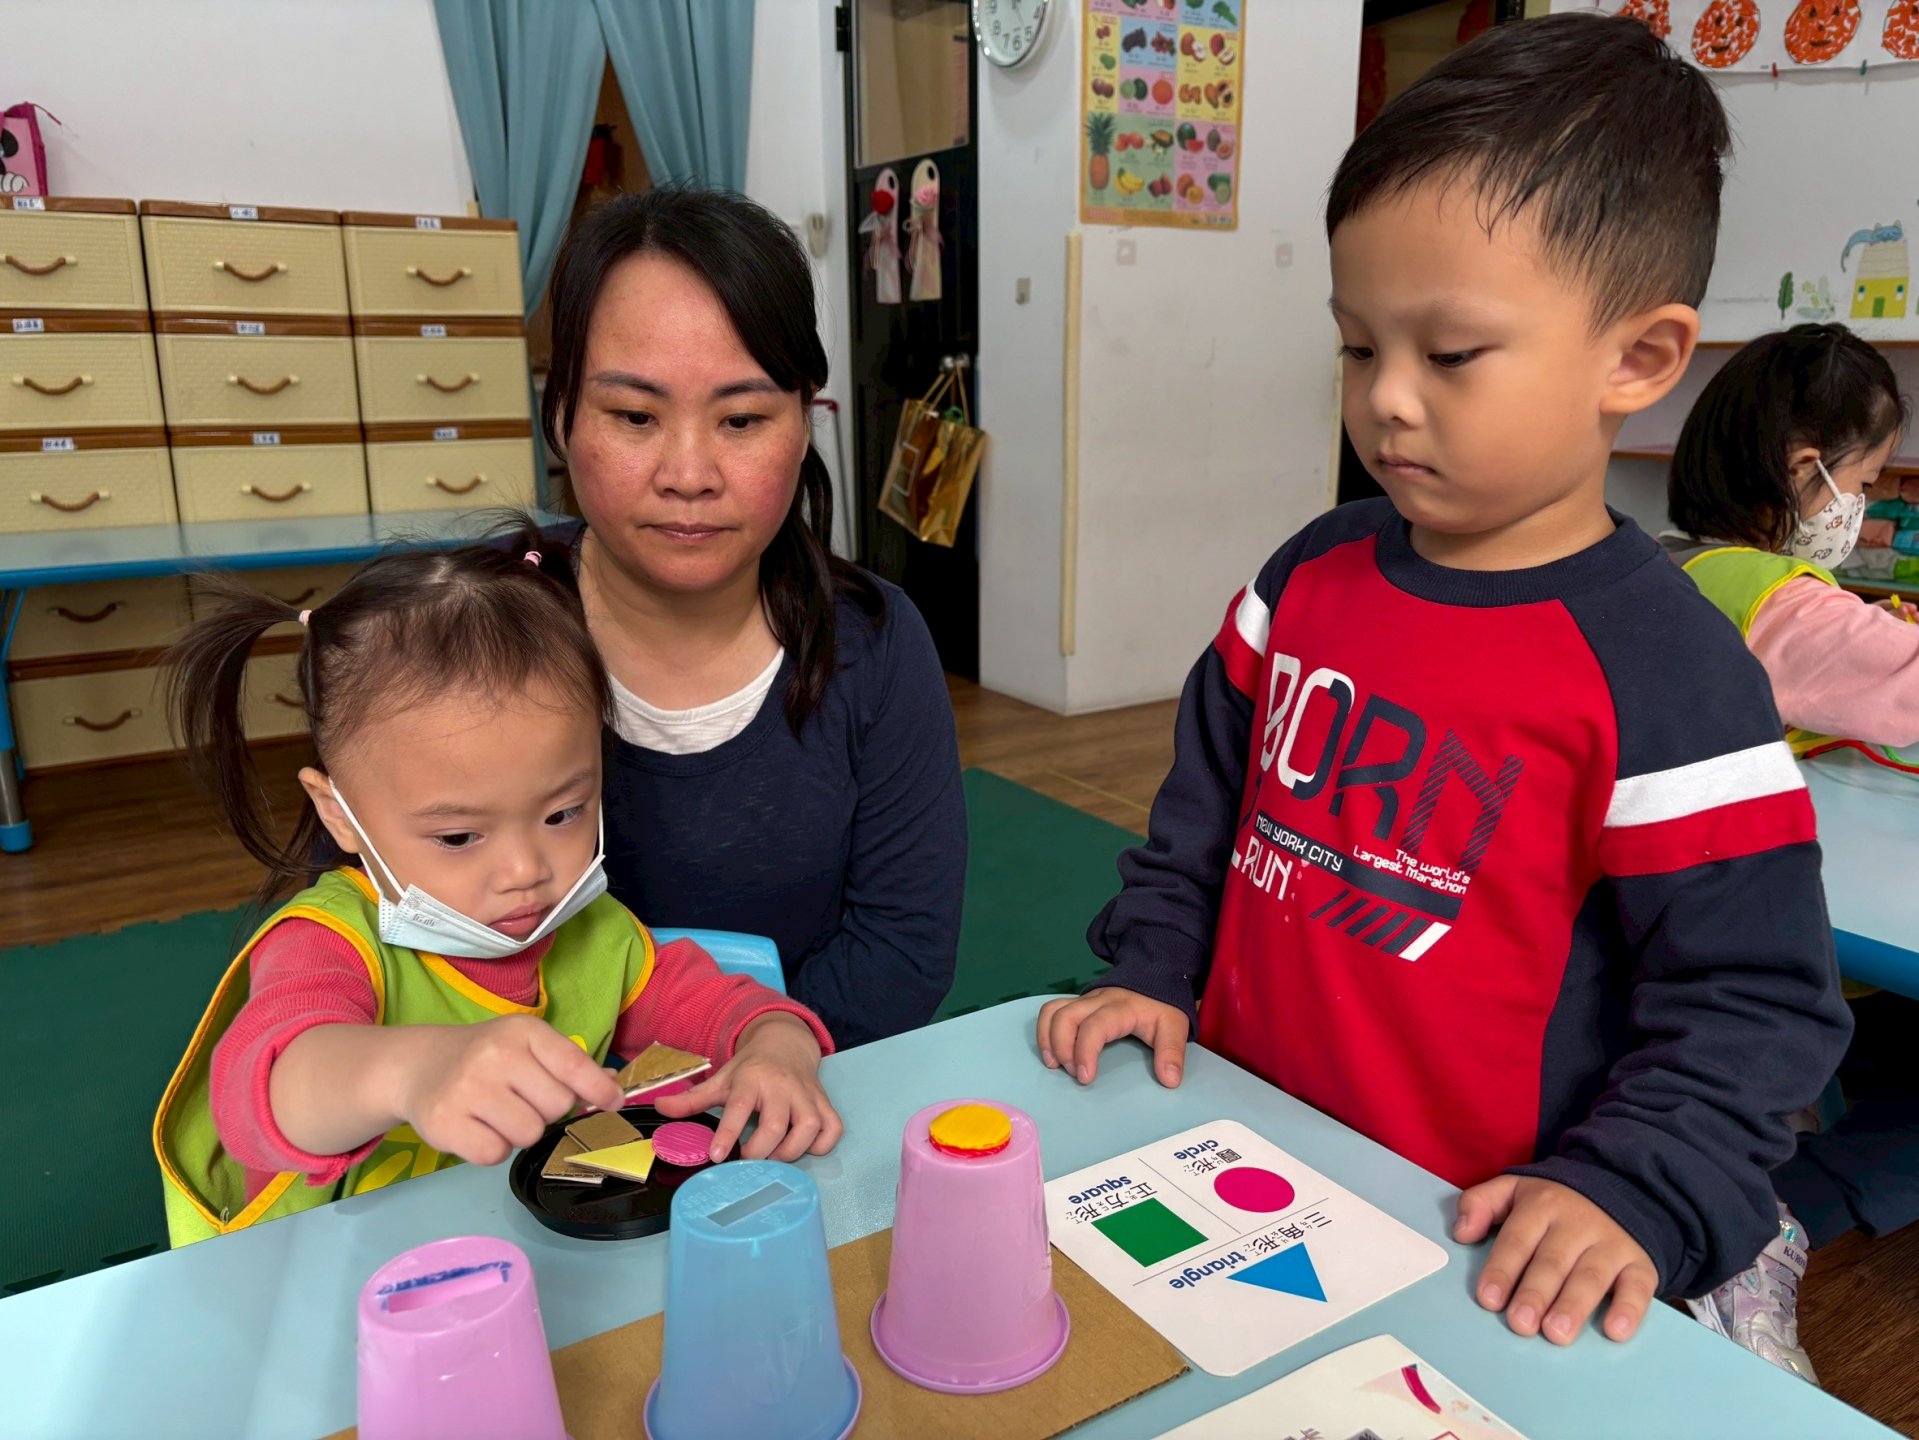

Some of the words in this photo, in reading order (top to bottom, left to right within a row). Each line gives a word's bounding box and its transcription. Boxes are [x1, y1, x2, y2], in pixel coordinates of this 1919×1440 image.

[1002, 33, 1010, 49] 7
[1012, 34, 1022, 51] 6
[1260, 652, 1525, 875] BORN
[1256, 814, 1272, 837] NEW
[1273, 827, 1308, 855] YORK
[1308, 845, 1343, 872] CITY
[1353, 845, 1403, 874] Largest
[1241, 835, 1293, 901] RUN
[1396, 848, 1417, 867] The
[1420, 861, 1471, 885] world's
[1173, 1139, 1219, 1160] circle
[1068, 1175, 1132, 1204] square
[1169, 1250, 1248, 1289] triangle
